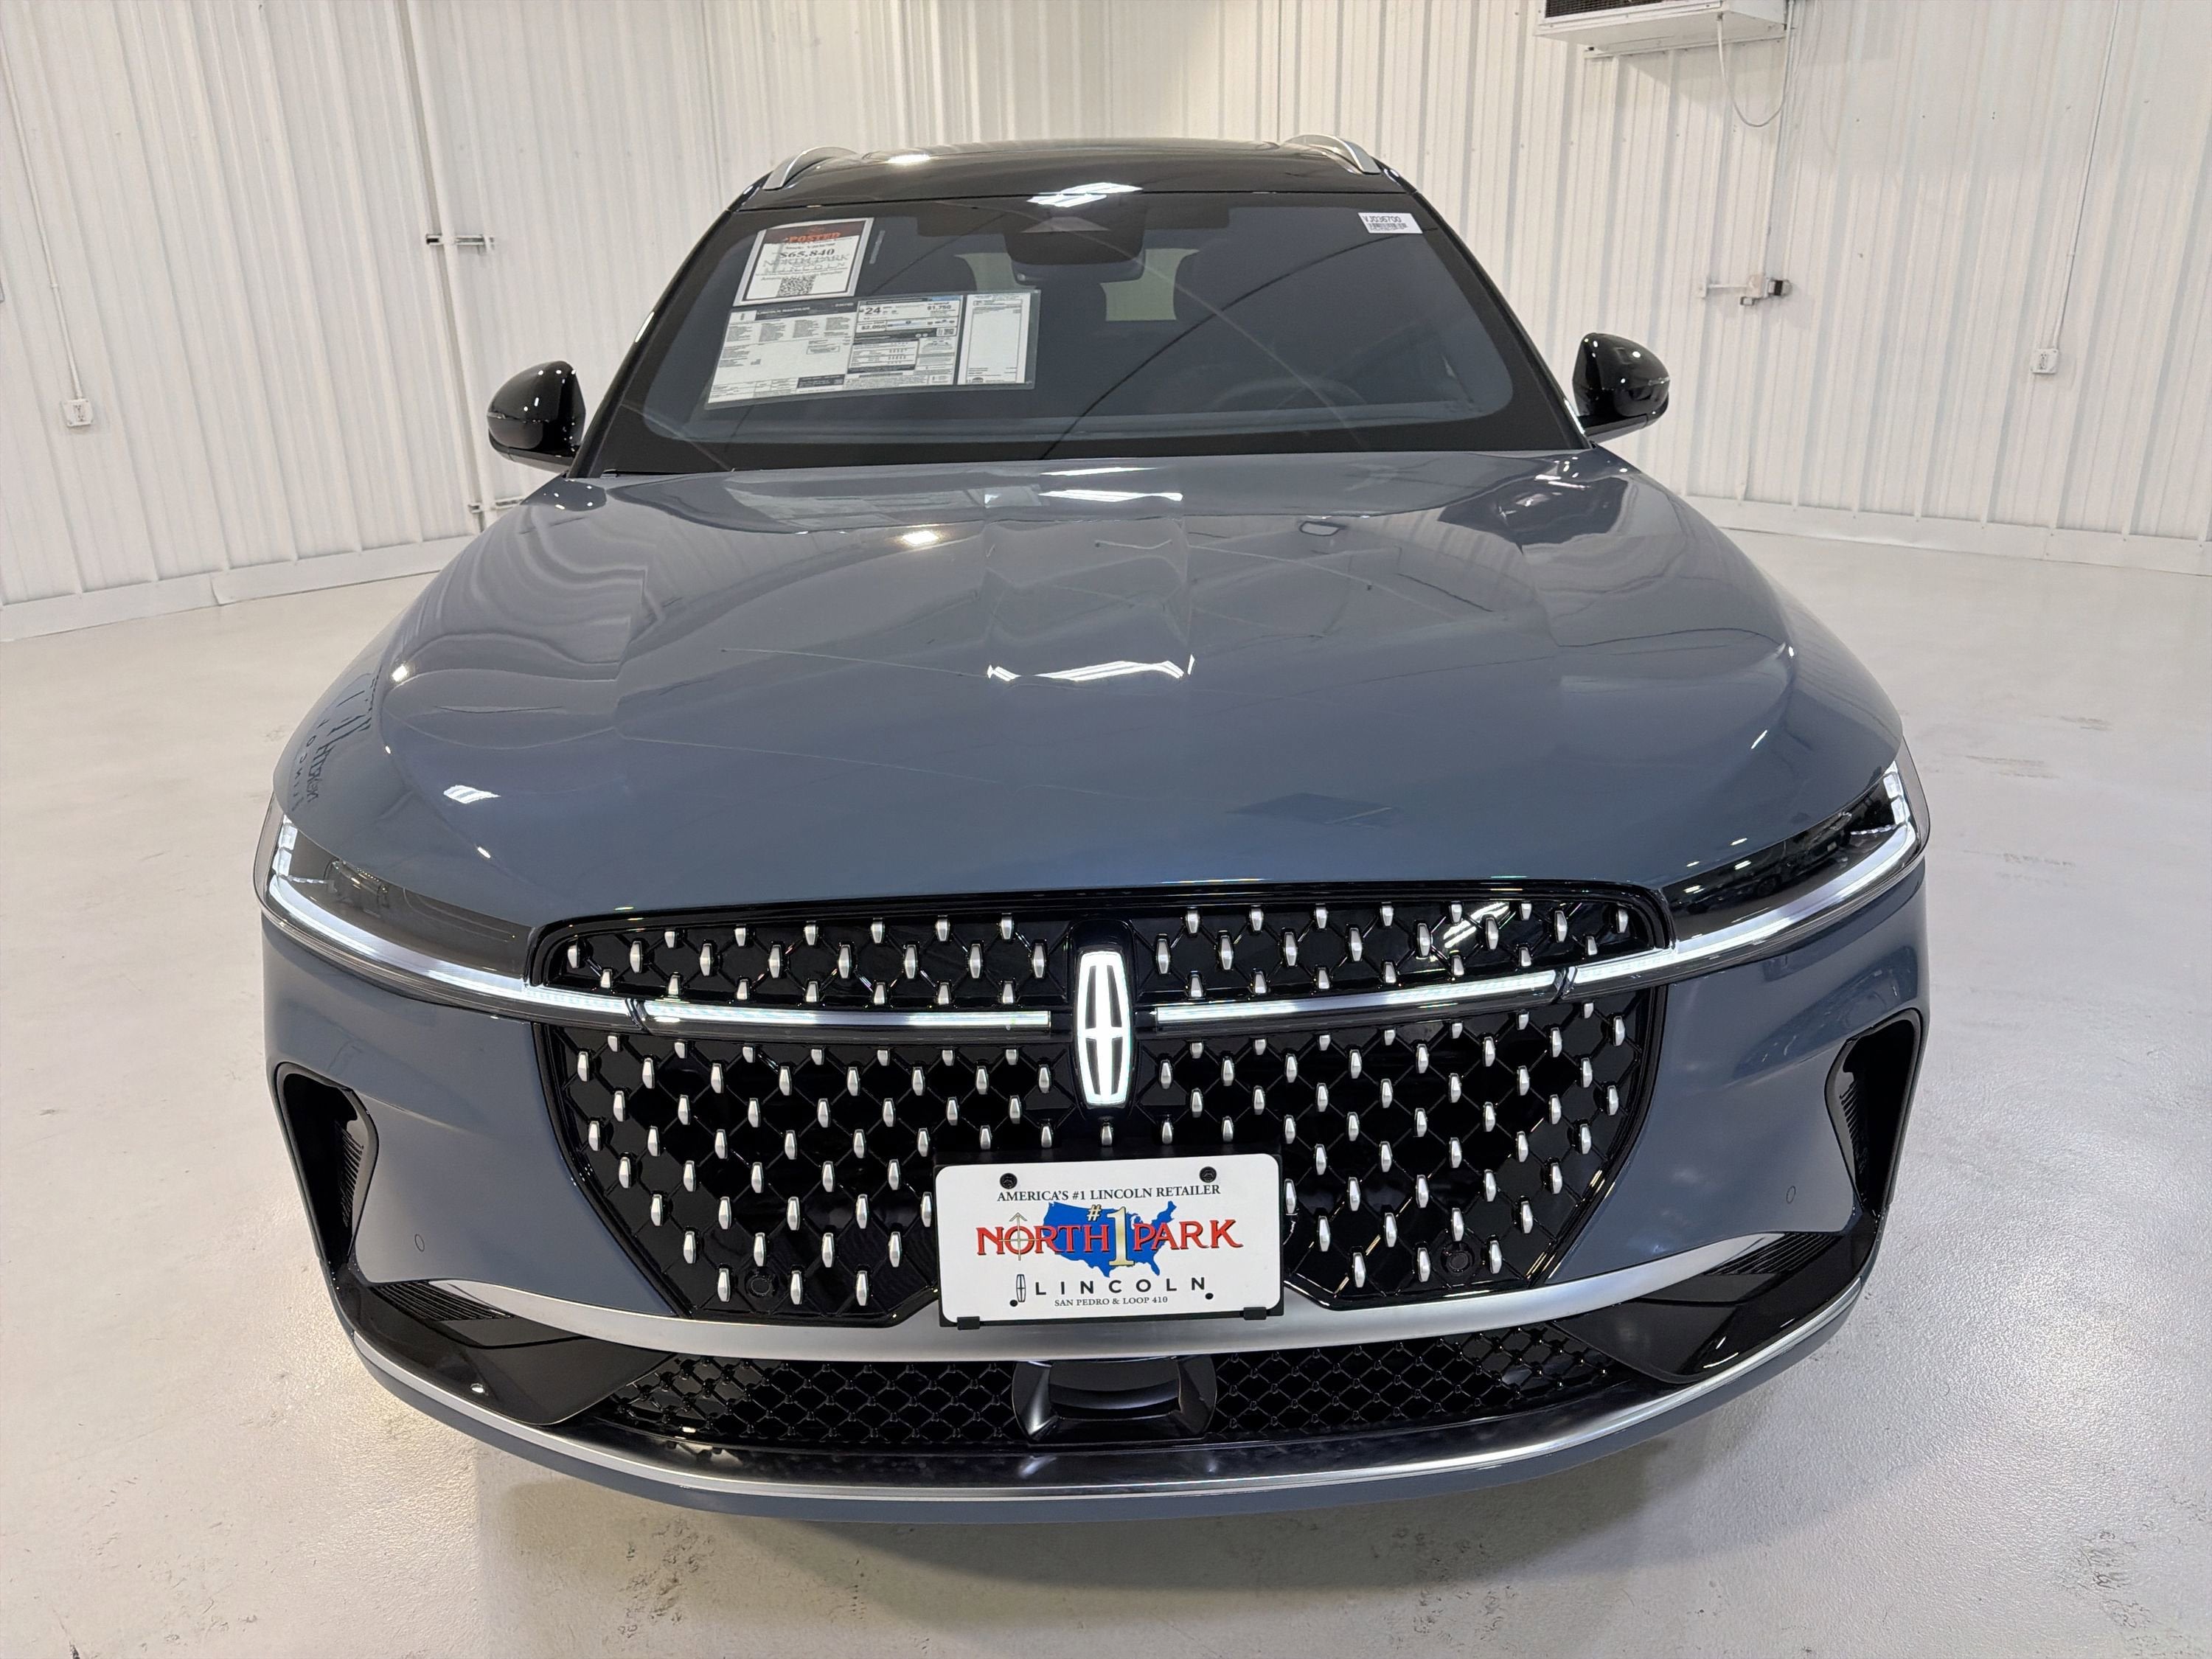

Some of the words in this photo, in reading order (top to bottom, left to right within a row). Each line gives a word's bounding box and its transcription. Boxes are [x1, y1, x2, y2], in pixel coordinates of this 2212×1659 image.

[865, 306, 881, 315] 24
[997, 1190, 1068, 1201] AMERICA'S
[1072, 1190, 1085, 1200] #1
[1090, 1188, 1152, 1200] LINCOLN
[1156, 1184, 1221, 1197] RETAILER
[976, 1224, 1109, 1255] NORTH
[1133, 1220, 1243, 1251] PARK
[1035, 1277, 1205, 1295] LINCOLN
[1077, 1298, 1110, 1306] PEDRO
